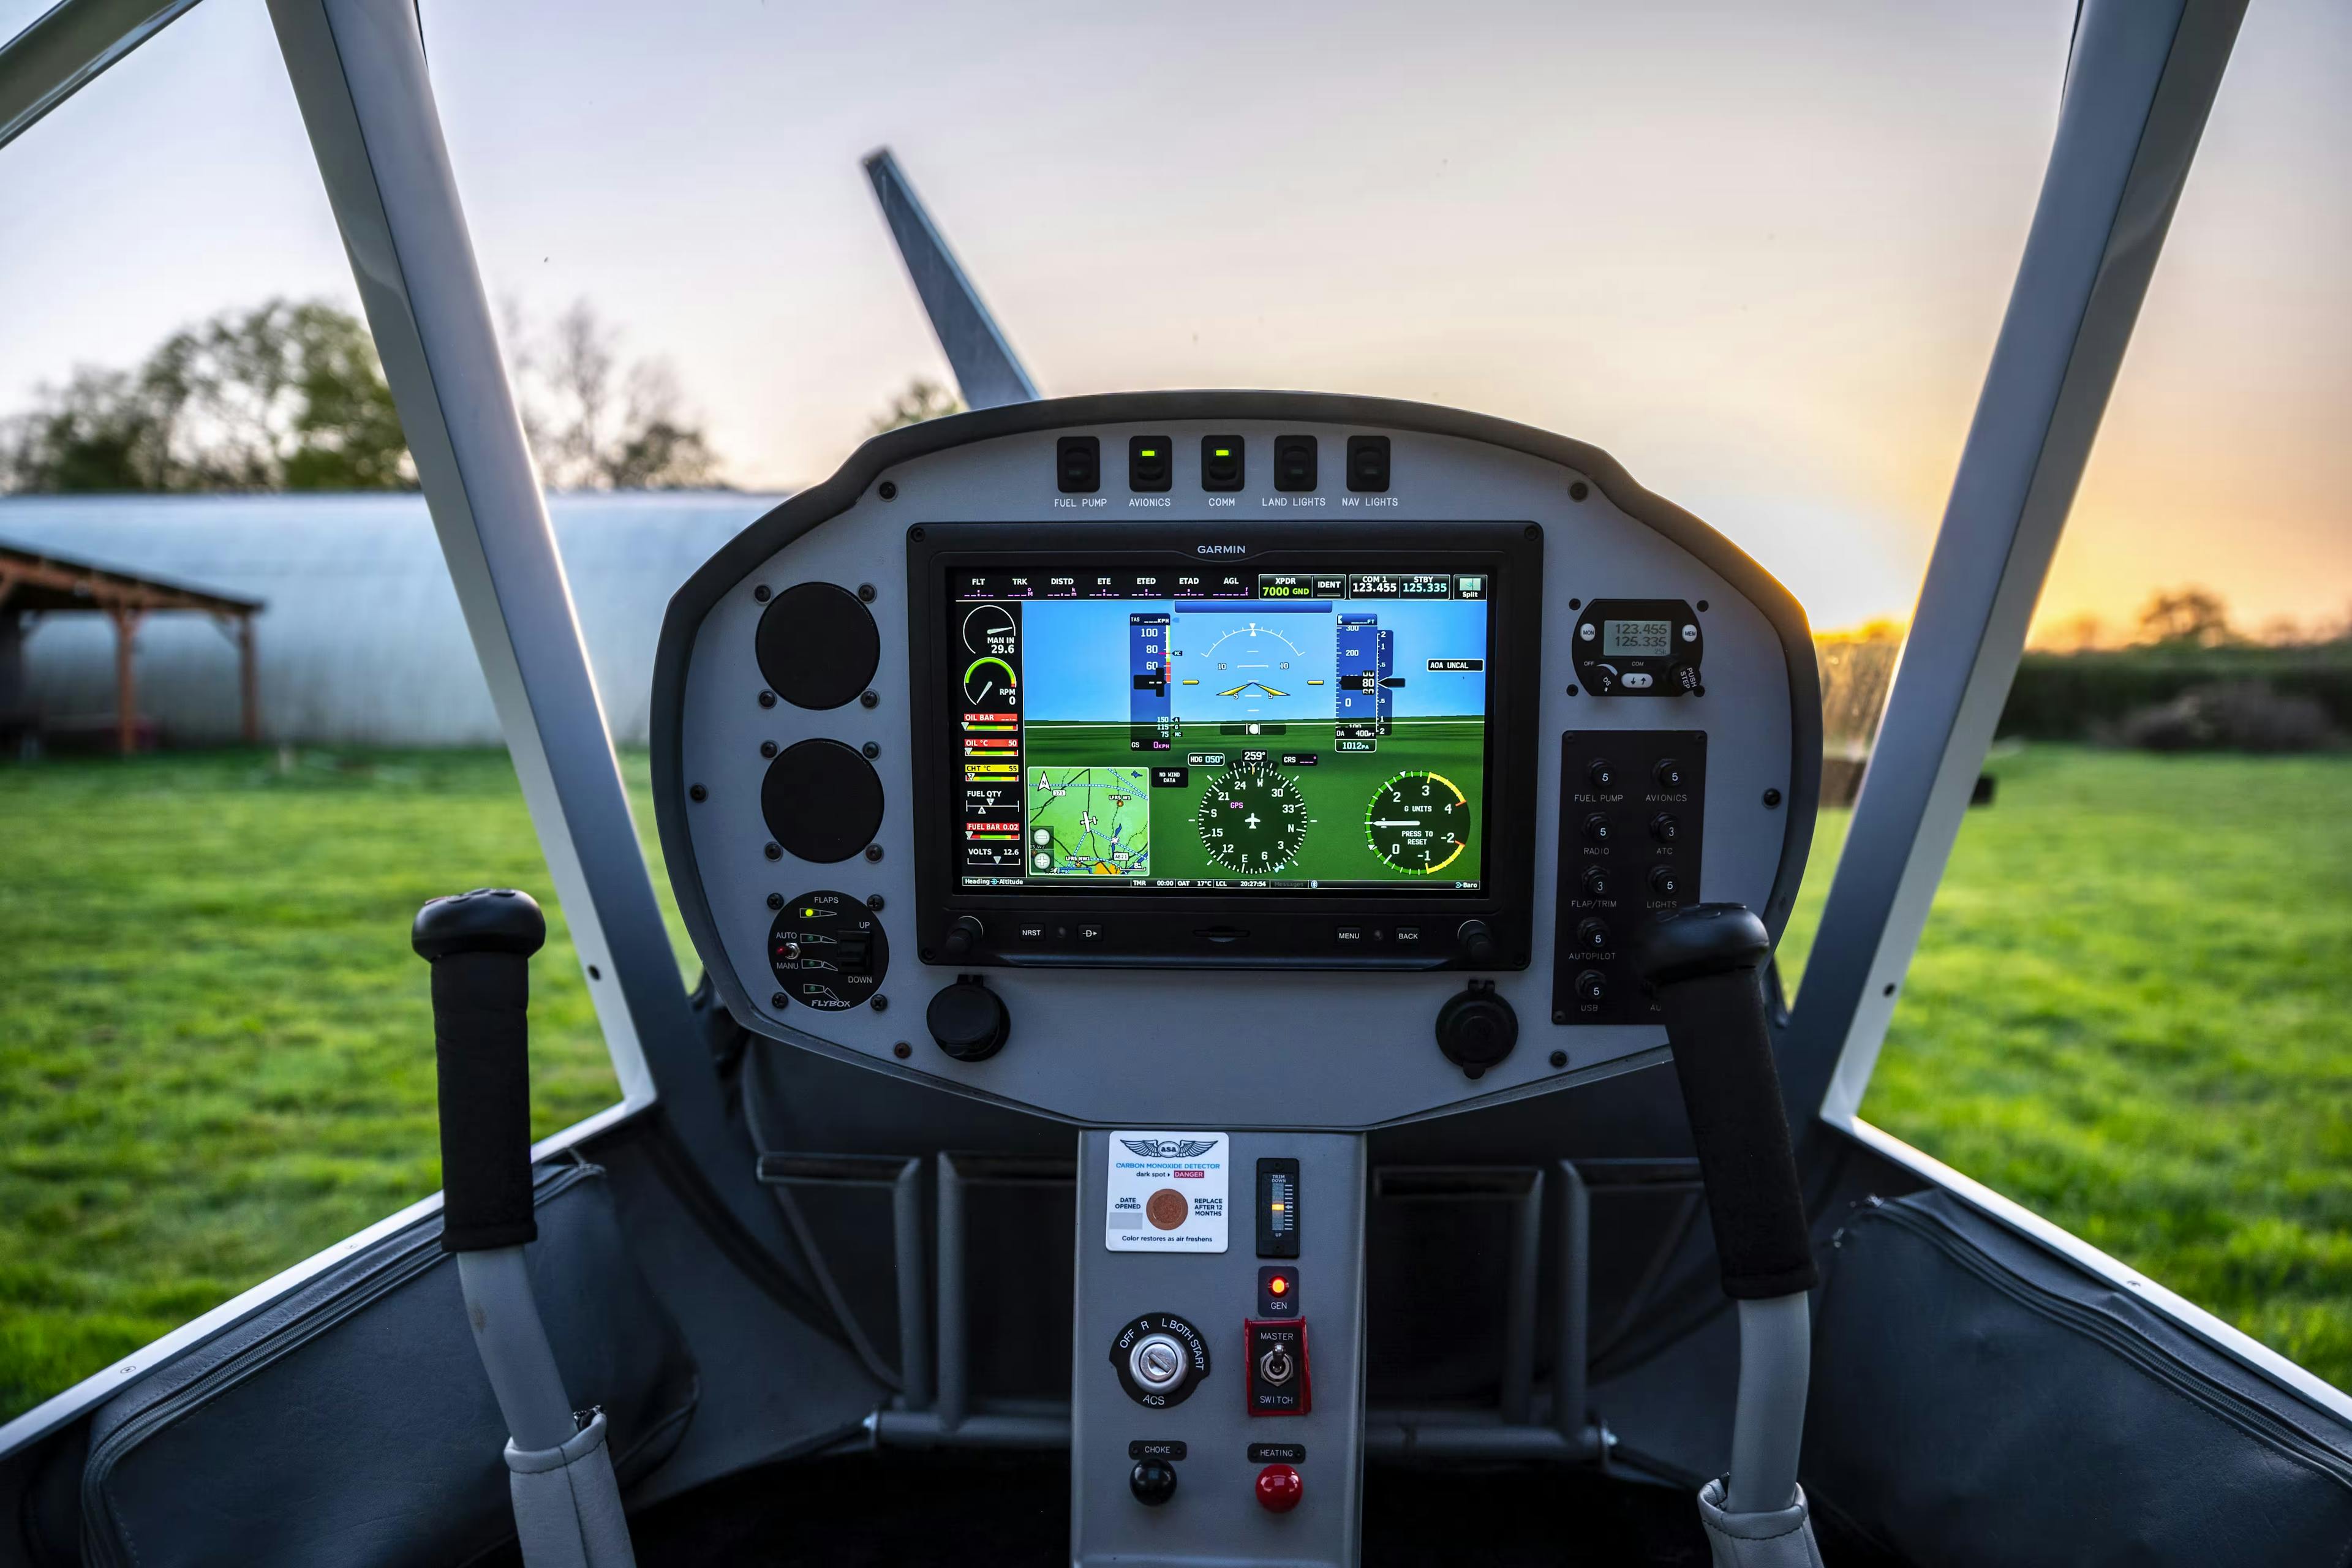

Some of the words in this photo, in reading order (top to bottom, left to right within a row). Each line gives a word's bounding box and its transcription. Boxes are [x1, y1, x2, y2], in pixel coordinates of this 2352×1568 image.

[1054, 499, 1077, 508] FUEL
[1082, 498, 1107, 507] PUMP
[1128, 498, 1171, 507] AVIONICS
[1208, 498, 1235, 507] COMM
[1262, 497, 1287, 507] LAND
[1292, 497, 1326, 507] LIGHTS
[1341, 497, 1360, 507] NAV
[1365, 497, 1398, 507] LIGHTS
[1197, 545, 1246, 554] GARMIN
[1262, 587, 1289, 596] 7000
[1352, 582, 1397, 592] 123.455
[1403, 583, 1447, 592] 125.335
[1140, 628, 1158, 637] 100
[1615, 624, 1667, 635] 123.455
[1615, 636, 1667, 647] 125.335
[990, 644, 1015, 654] 29.6
[1146, 645, 1158, 654] 80
[1146, 662, 1158, 670] 60
[1680, 671, 1691, 690] STEP
[1687, 667, 1697, 688] PUSH
[1362, 679, 1374, 687] 80
[1234, 782, 1246, 790] 24
[1257, 779, 1264, 788] W
[1271, 788, 1284, 797] 30
[1422, 785, 1430, 796] 3
[1218, 792, 1230, 801] 21
[1393, 791, 1401, 802] 2
[1282, 804, 1295, 813] 33
[1212, 828, 1223, 837] 15
[1441, 832, 1454, 843] -2
[1222, 844, 1234, 853] 12
[1417, 850, 1431, 861] -1
[1571, 900, 1617, 909] FLAP/TRIM
[1140, 1321, 1149, 1330] R
[1169, 1320, 1194, 1341] BOTH
[1119, 1329, 1135, 1349] OFF
[1261, 1332, 1294, 1341] MASTER
[1189, 1340, 1204, 1371] START
[1142, 1395, 1165, 1406] ACS
[1259, 1395, 1293, 1404] SWITCH
[1144, 1446, 1170, 1454] CHOKE
[1260, 1449, 1293, 1458] HEATING
